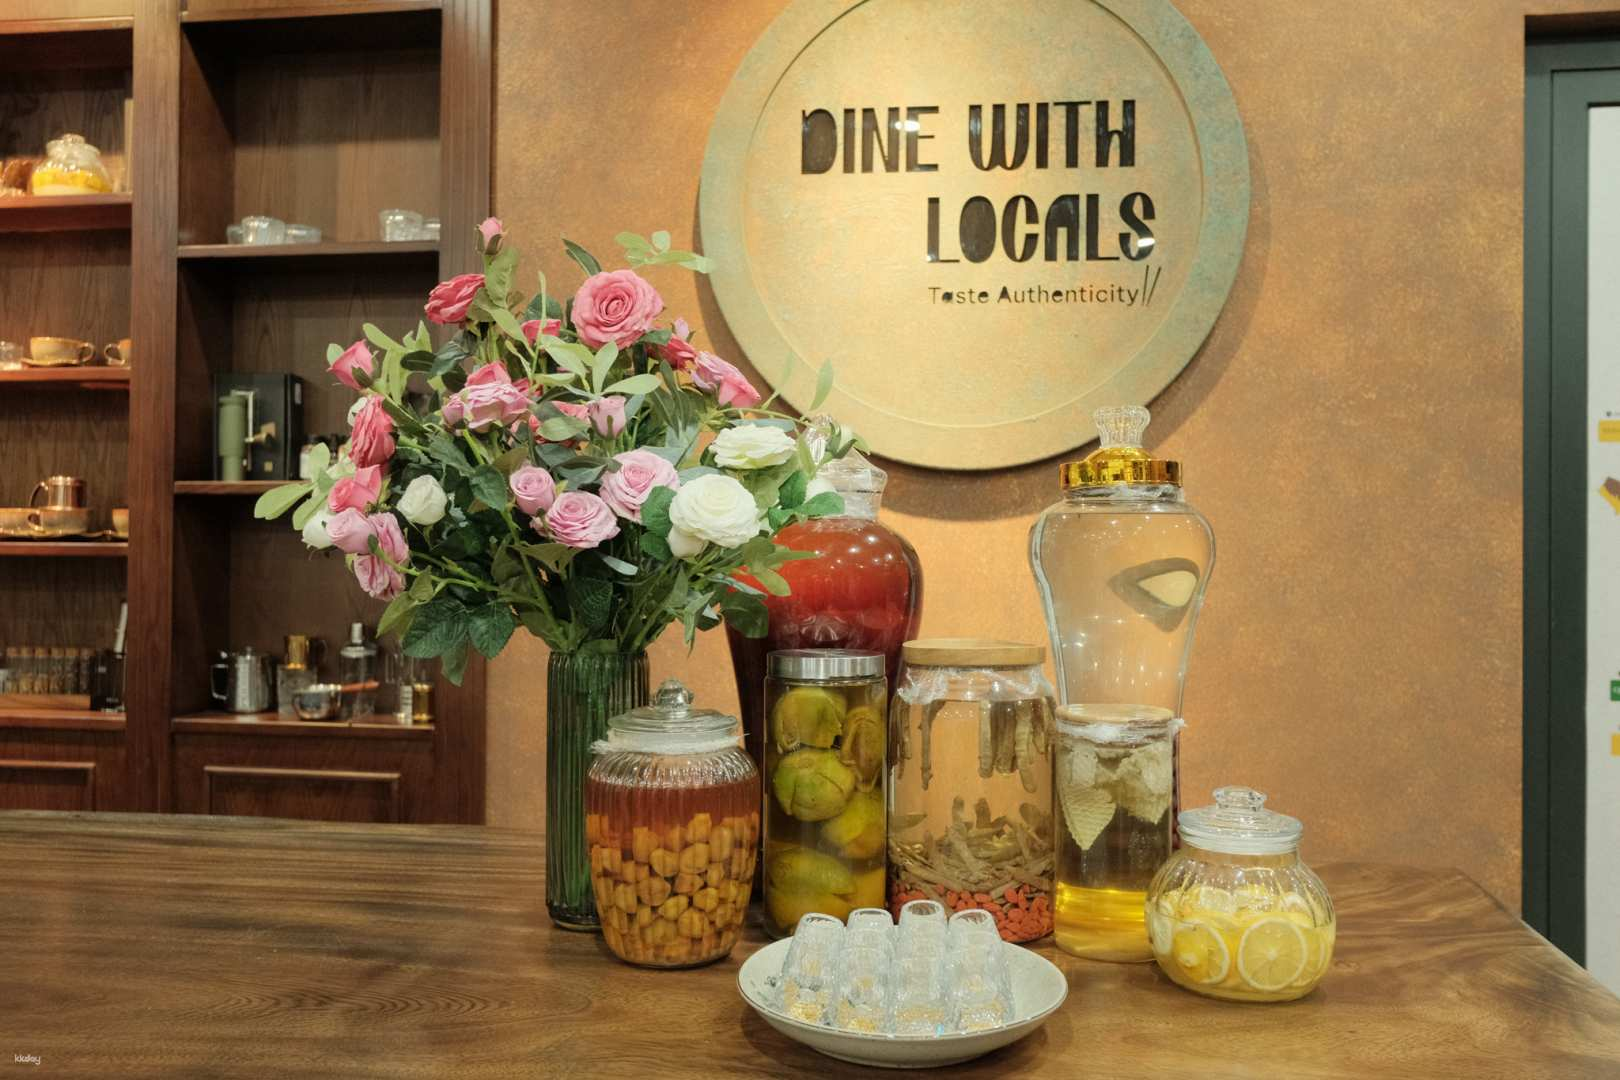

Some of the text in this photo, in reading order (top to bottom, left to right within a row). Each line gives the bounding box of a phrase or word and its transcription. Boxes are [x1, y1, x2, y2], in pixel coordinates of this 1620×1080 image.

[801, 99, 1136, 174] DINE WITH
[927, 192, 1156, 263] LOCALS
[928, 286, 989, 305] Taste
